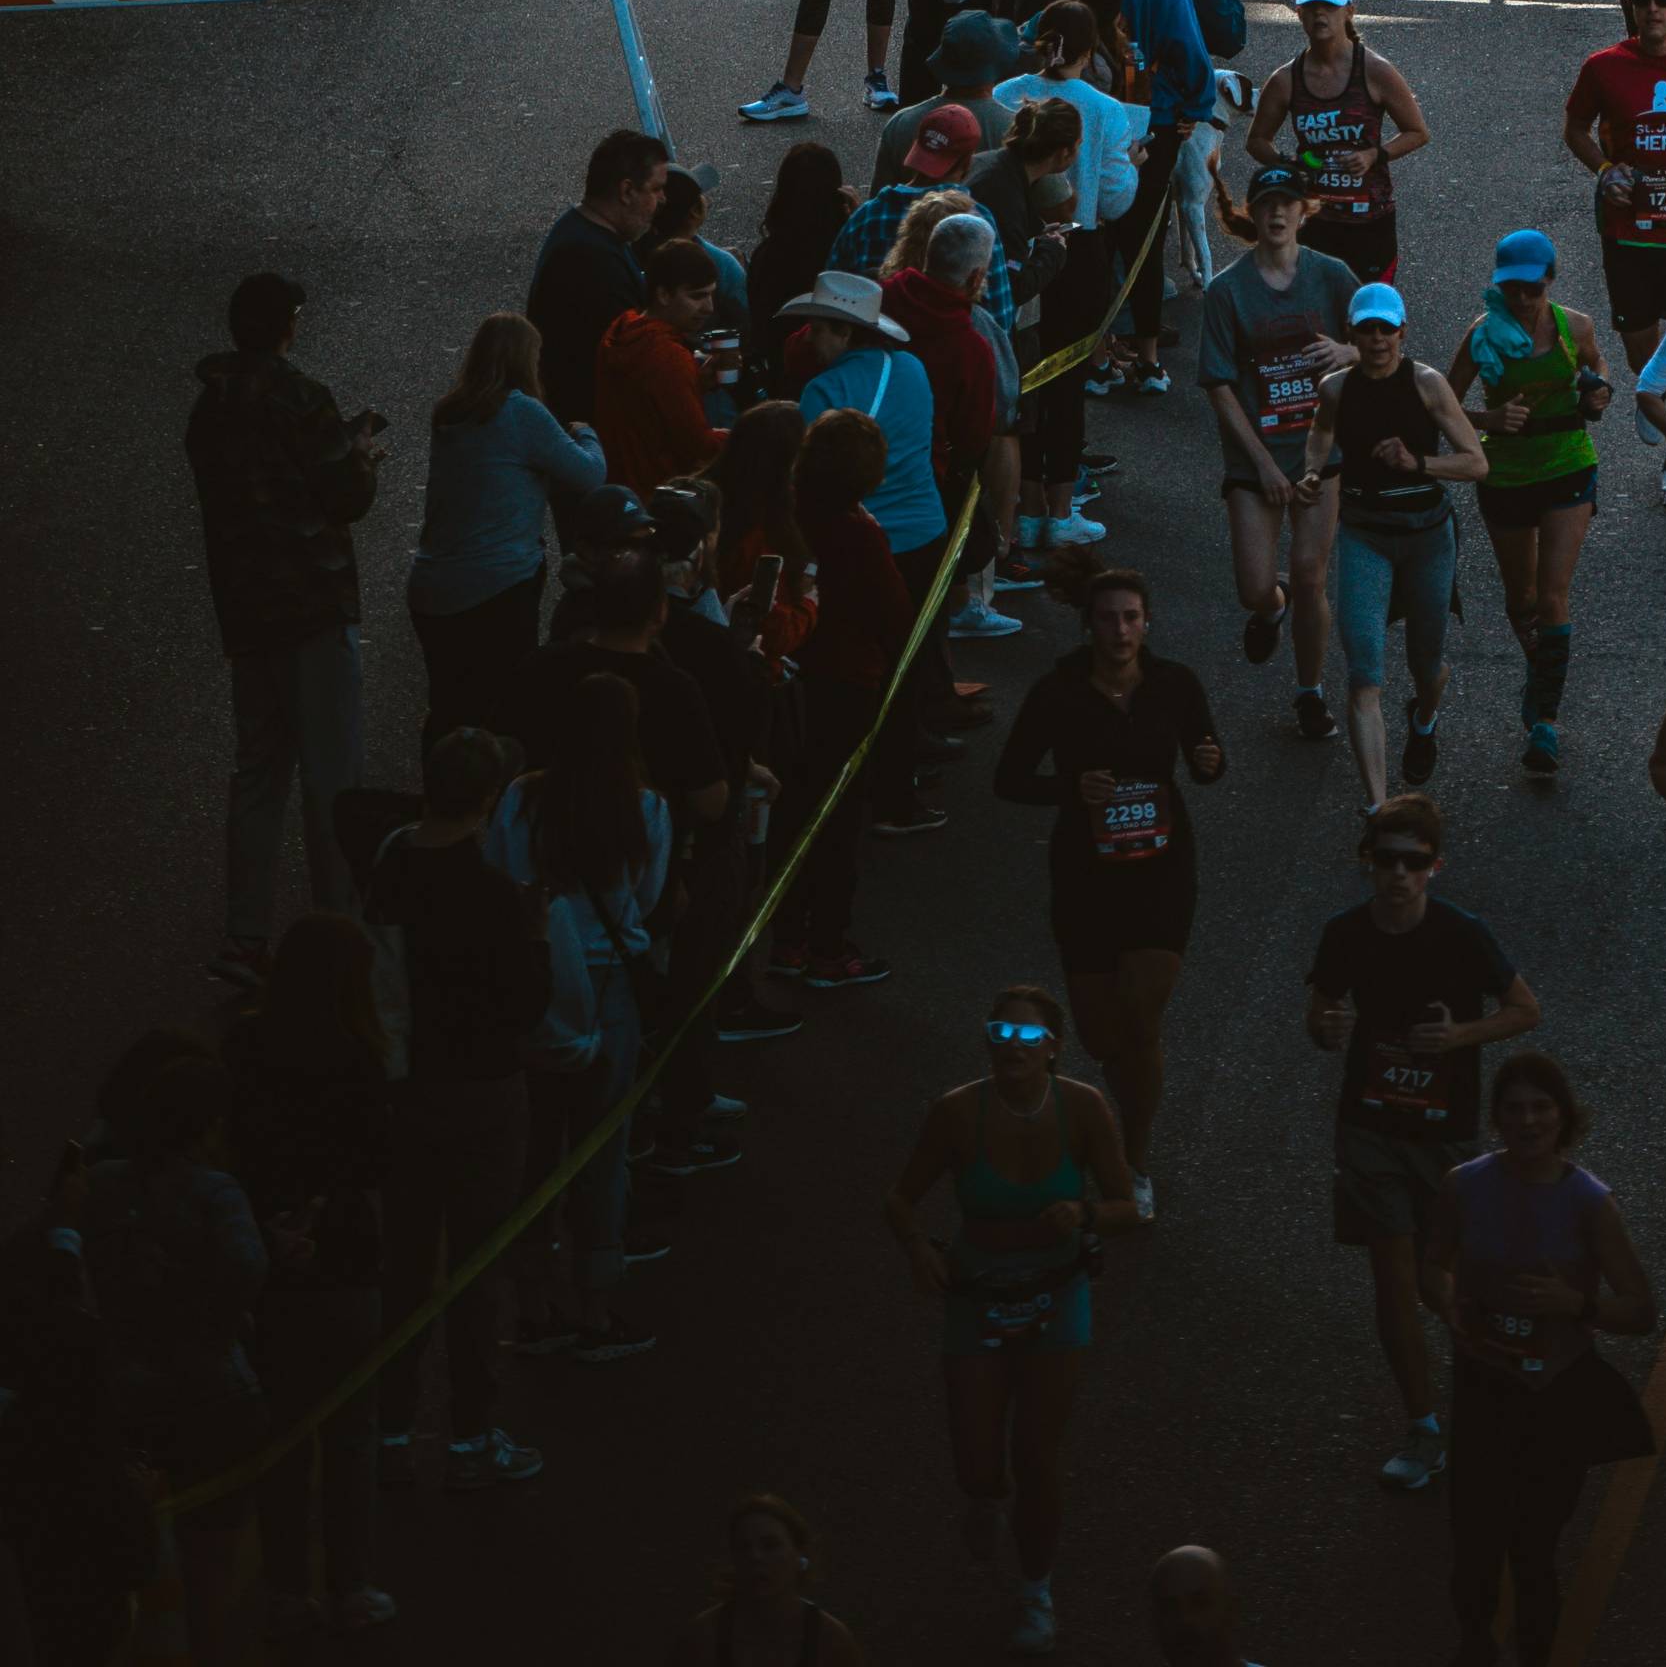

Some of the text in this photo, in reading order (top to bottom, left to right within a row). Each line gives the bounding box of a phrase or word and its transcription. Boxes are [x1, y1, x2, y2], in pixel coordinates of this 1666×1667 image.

[1296, 110, 1341, 130] EAST
[1308, 123, 1364, 144] NASTY
[1269, 378, 1313, 399] 5885
[1105, 802, 1156, 825] 2298
[1382, 1067, 1434, 1088] 4717
